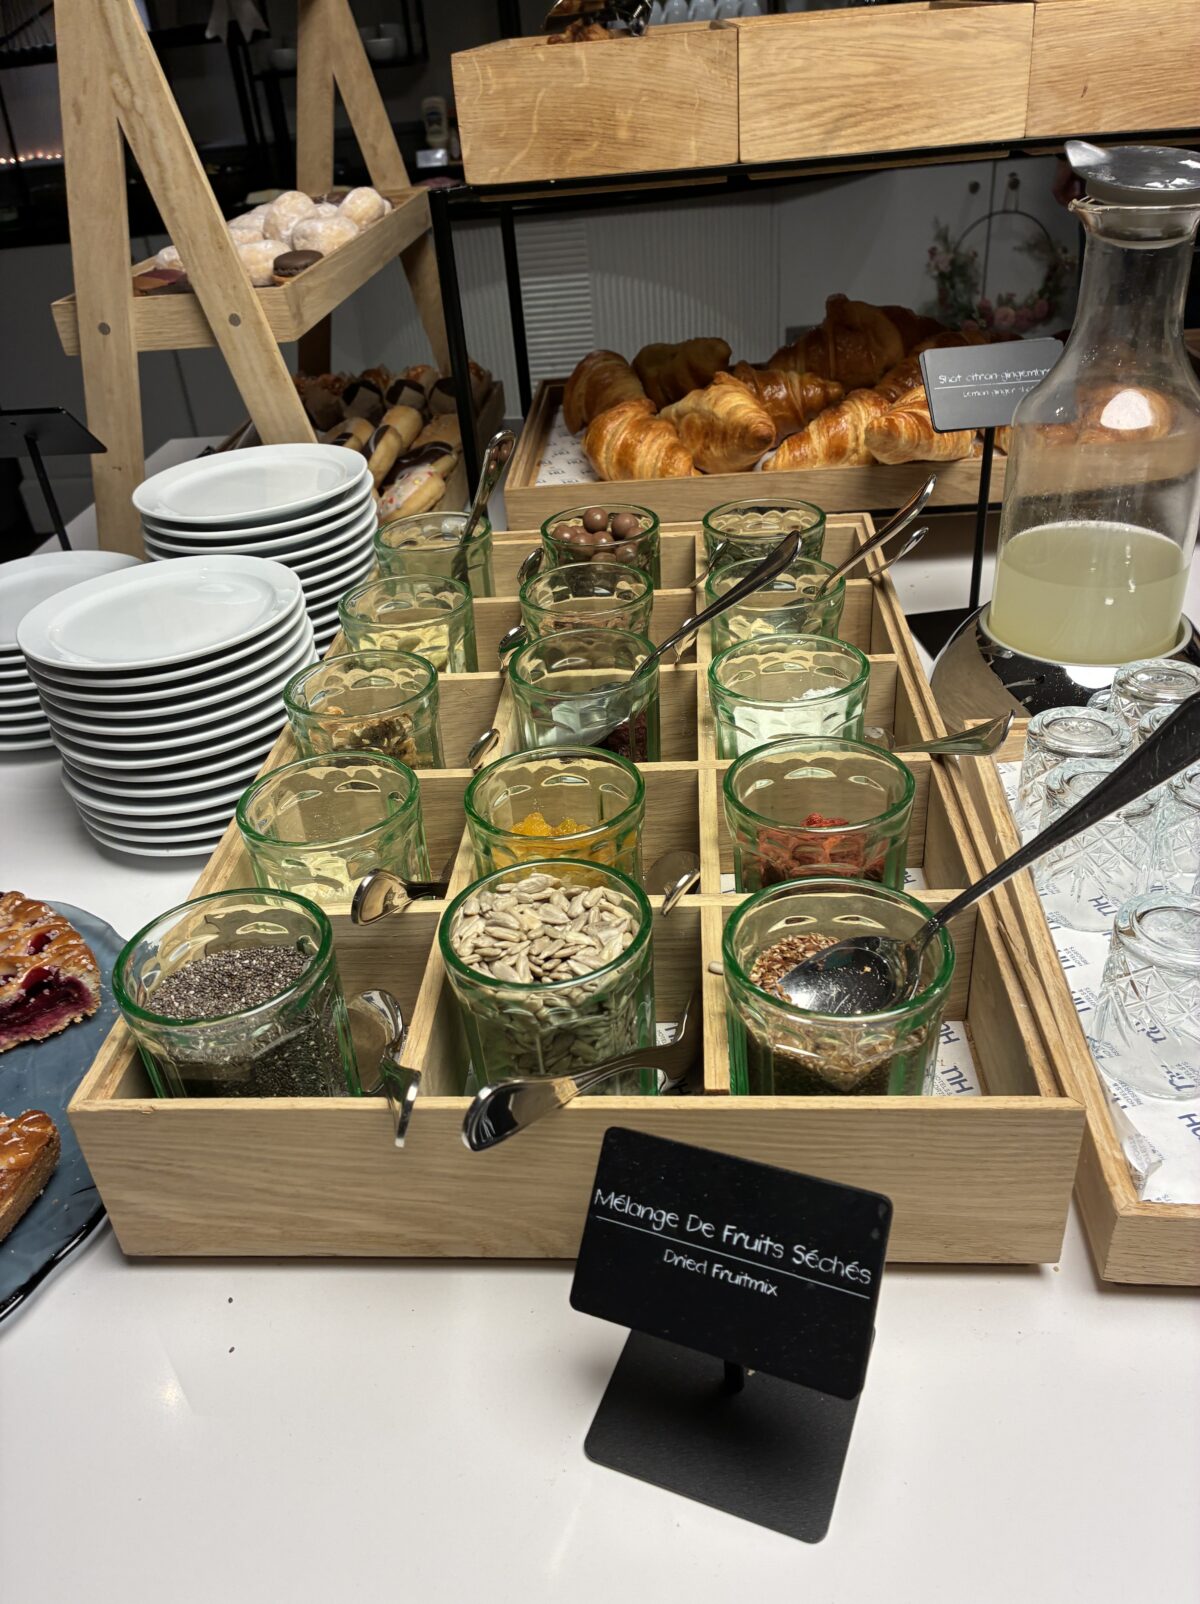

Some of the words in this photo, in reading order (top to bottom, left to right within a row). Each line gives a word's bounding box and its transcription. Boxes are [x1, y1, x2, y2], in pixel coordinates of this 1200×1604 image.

[594, 1188, 680, 1231] Mélange
[686, 1214, 716, 1239] De
[722, 1224, 785, 1260] Fruits
[791, 1244, 872, 1285] Séchés
[663, 1248, 708, 1275] Dried
[711, 1263, 778, 1297] Fruitmix
